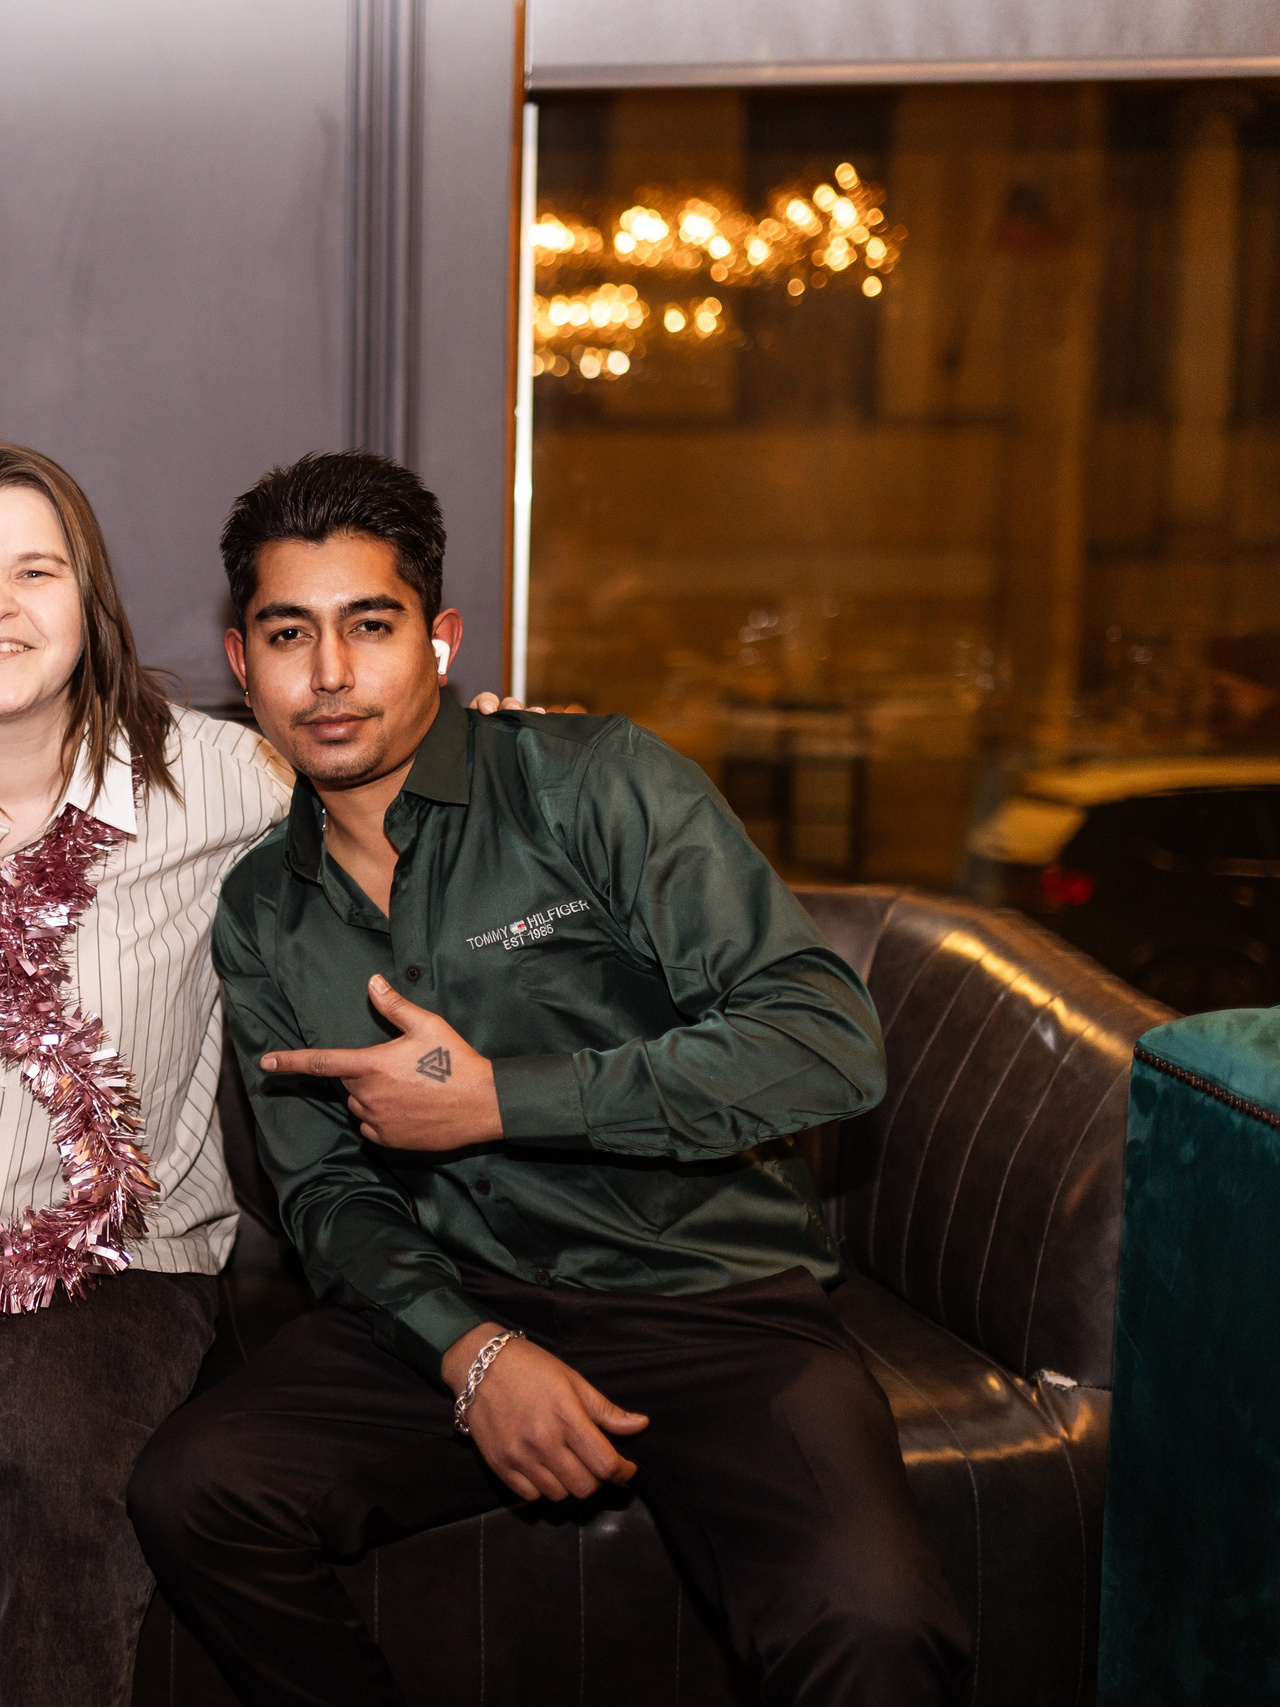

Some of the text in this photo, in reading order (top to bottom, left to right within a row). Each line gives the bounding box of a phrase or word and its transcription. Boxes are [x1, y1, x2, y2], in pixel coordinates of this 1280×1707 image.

[466, 899, 590, 950] TOMMY HILFIGER
[503, 923, 554, 950] EST 1985
